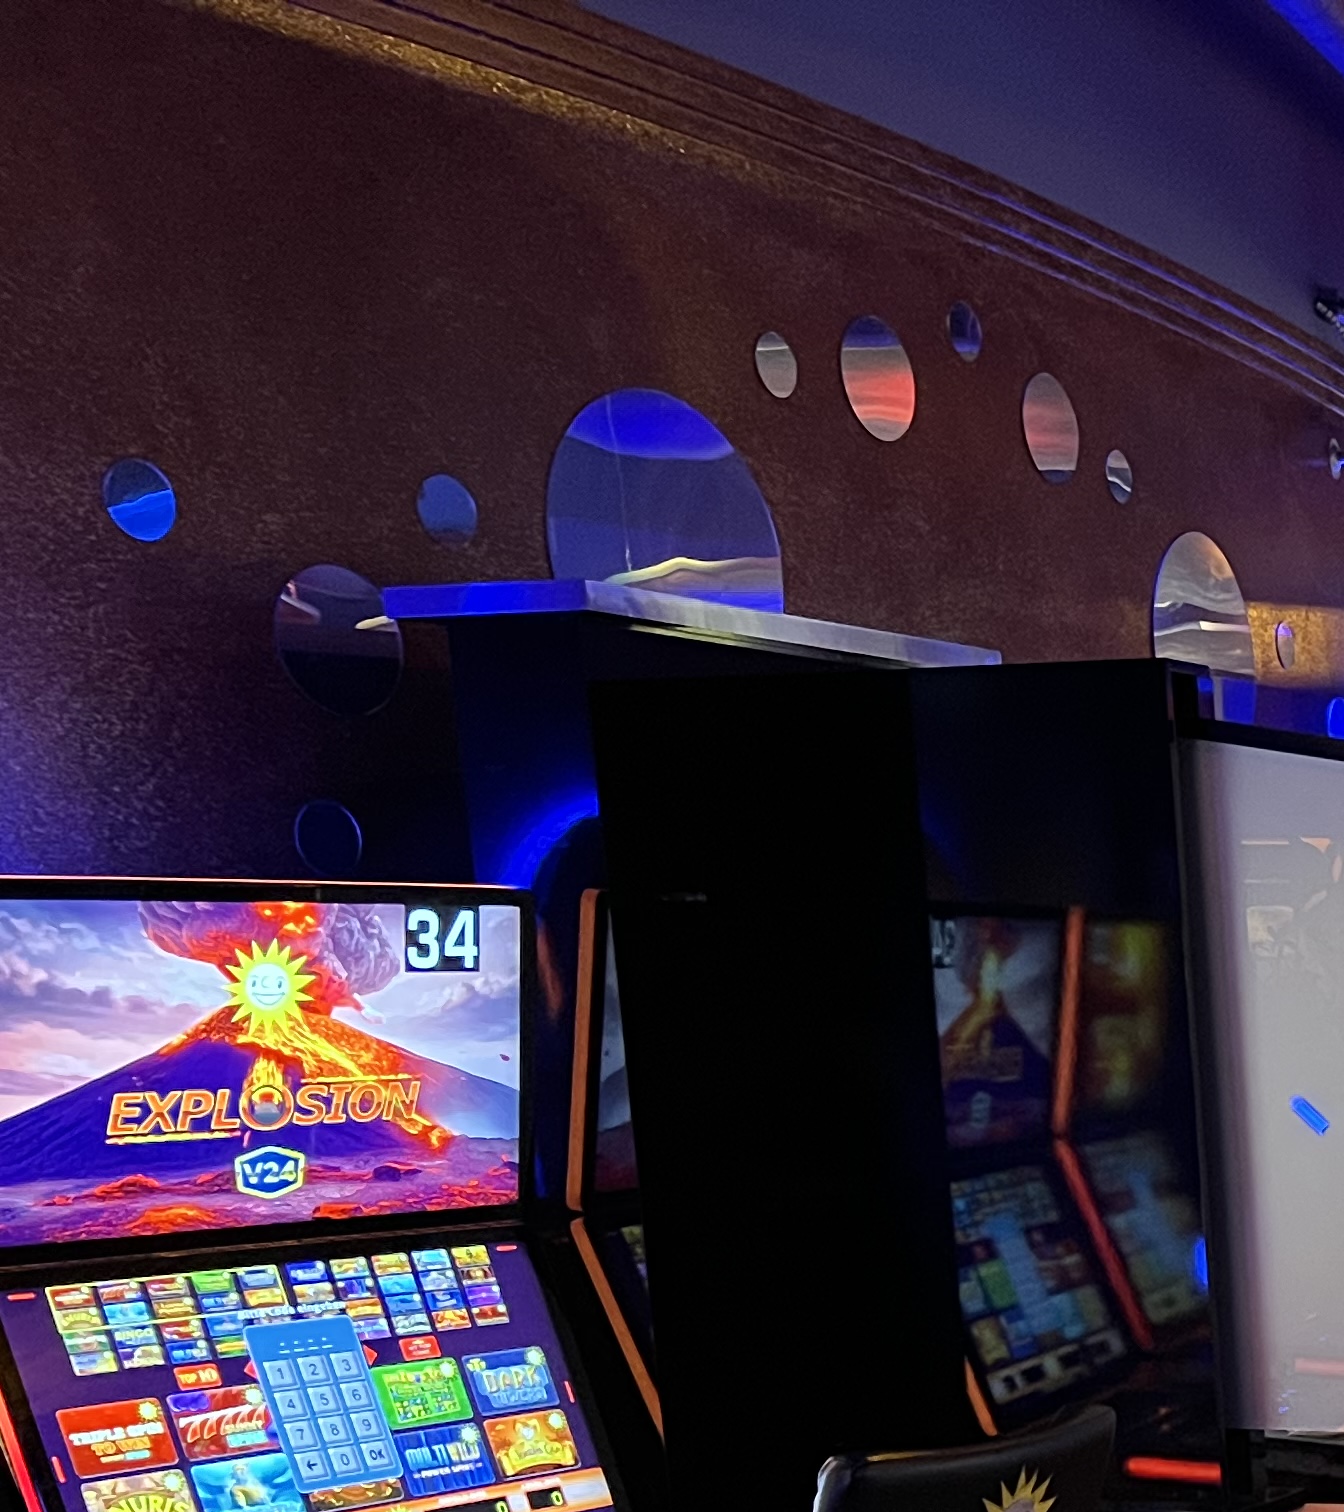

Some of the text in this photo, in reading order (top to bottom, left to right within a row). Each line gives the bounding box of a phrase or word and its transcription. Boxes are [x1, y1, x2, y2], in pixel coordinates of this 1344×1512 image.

[406, 908, 479, 970] 34
[106, 1081, 421, 1131] EXPLOSION
[241, 1160, 298, 1185] V24
[198, 1367, 218, 1383] 10
[276, 1358, 352, 1380] 1 2 3
[286, 1388, 362, 1409] 4 5 6
[295, 1418, 372, 1441] 7 8 9
[340, 1448, 385, 1467] 0 OK
[550, 1490, 565, 1506] 0
